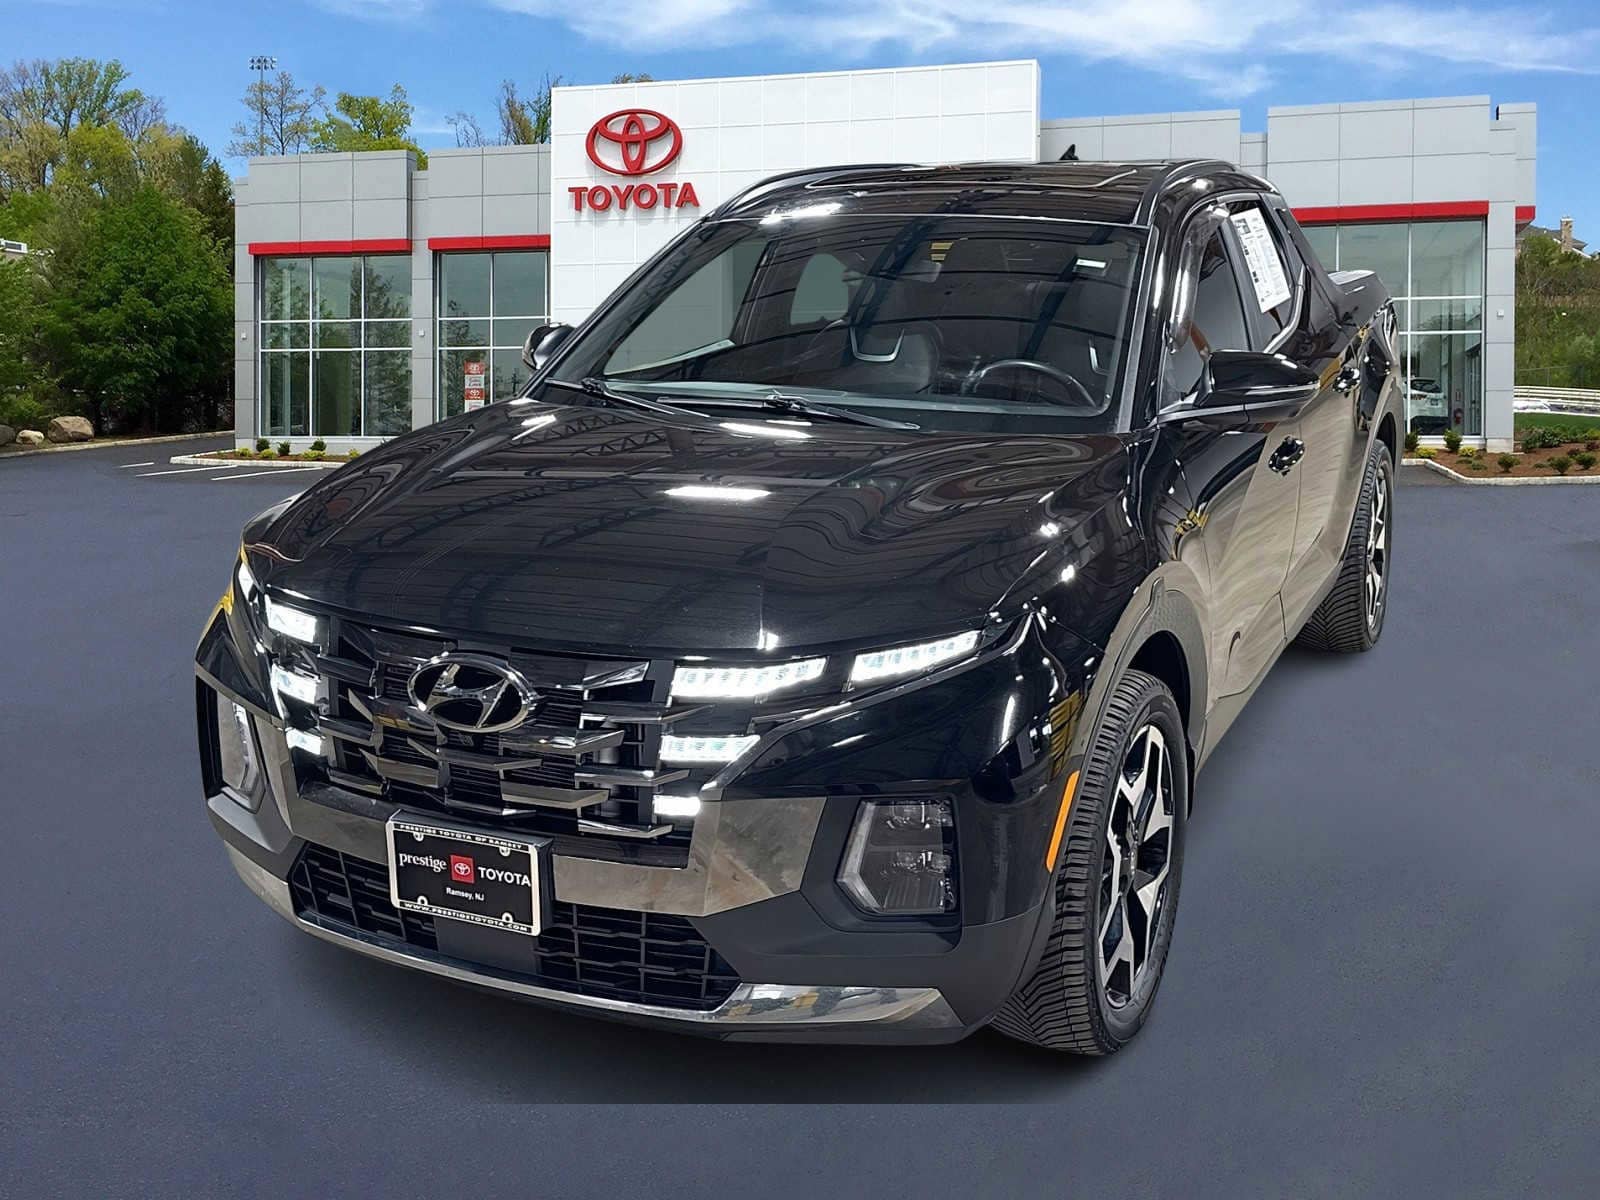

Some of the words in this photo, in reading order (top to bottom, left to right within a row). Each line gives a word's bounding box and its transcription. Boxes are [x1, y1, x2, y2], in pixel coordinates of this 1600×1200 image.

[568, 182, 699, 211] TOYOTA
[400, 824, 437, 834] PRESTIGE
[440, 830, 472, 840] TOYOTA
[489, 839, 522, 849] RAMSEY
[399, 853, 447, 873] prestige
[477, 866, 531, 886] TOYOTA
[446, 887, 474, 901] Ramsey,
[475, 892, 485, 901] NJ
